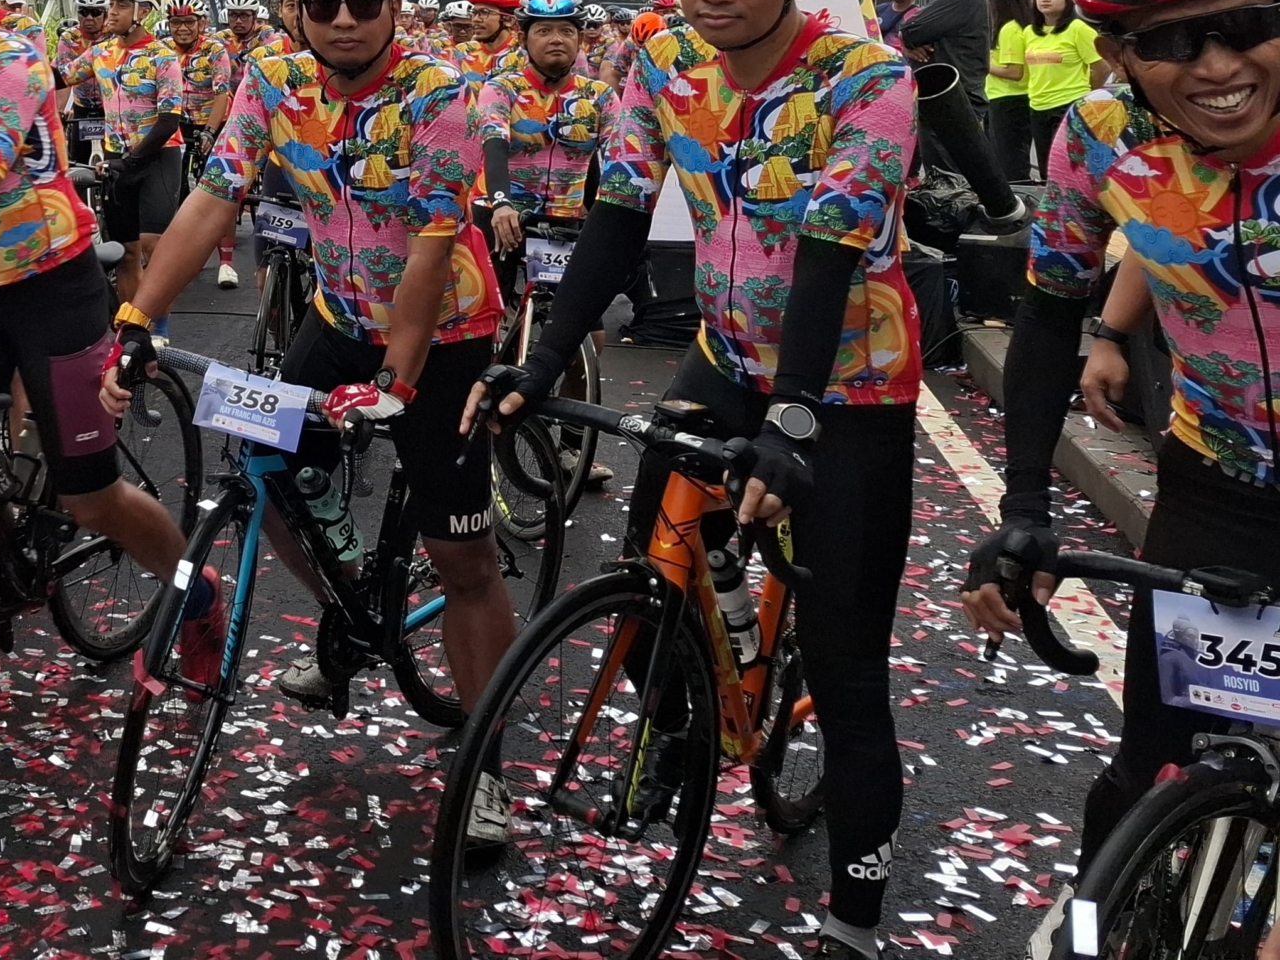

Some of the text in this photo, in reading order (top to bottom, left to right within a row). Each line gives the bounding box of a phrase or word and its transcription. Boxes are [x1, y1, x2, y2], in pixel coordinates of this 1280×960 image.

[271, 215, 293, 229] 159
[226, 384, 279, 414] 358
[220, 405, 231, 415] RAY
[232, 407, 252, 421] FRANC
[262, 416, 277, 427] AZIS
[221, 614, 243, 679] GIANT
[1196, 633, 1280, 679] 345
[1223, 675, 1260, 692] ROSYID
